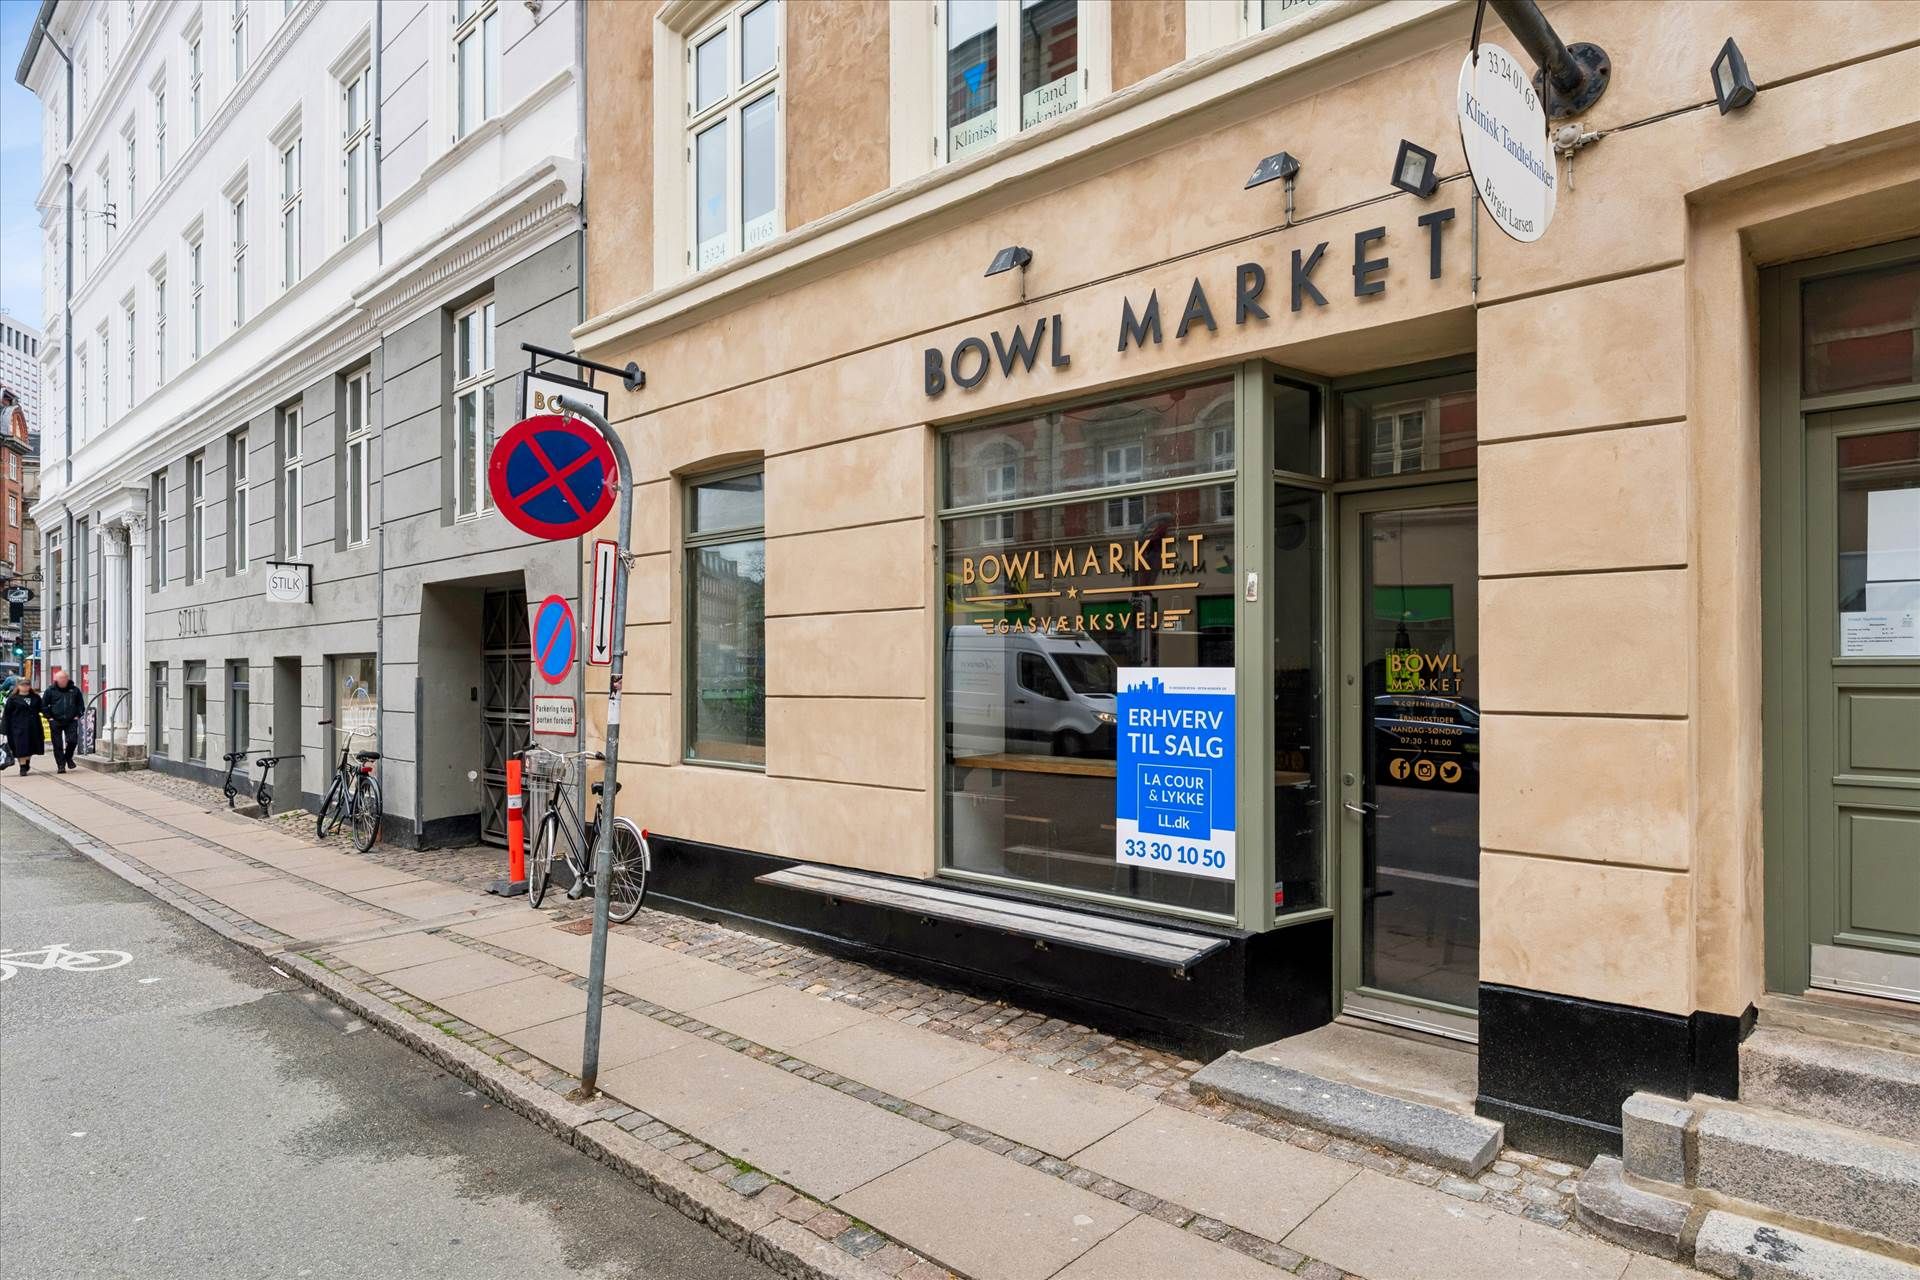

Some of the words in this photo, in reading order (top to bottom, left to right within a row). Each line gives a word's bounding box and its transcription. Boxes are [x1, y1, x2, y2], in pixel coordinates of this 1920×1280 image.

[1035, 78, 1068, 106] Tand
[1488, 51, 1499, 75] 33
[1501, 58, 1511, 83] 24
[1513, 69, 1523, 94] 01
[1525, 88, 1535, 112] 63
[954, 119, 998, 150] Klinisk
[1465, 92, 1499, 142] Klinisk
[1502, 125, 1554, 190] Tandtekniker
[1485, 178, 1507, 217] Birgit
[1509, 208, 1534, 233] Larsen
[750, 221, 773, 242] 0163
[924, 313, 1071, 397] BOWL
[1118, 207, 1456, 352] MARKET
[271, 576, 300, 590] STILK
[997, 612, 1158, 635] GASVÆRKSVEJ
[1391, 654, 1462, 673] BOWL
[1391, 678, 1462, 691] MARKET
[536, 705, 559, 714] Parkering
[1129, 708, 1223, 730] ERHVERV
[554, 717, 573, 725] forbudt
[1127, 733, 1160, 754] TIL
[1164, 734, 1224, 759] SALG
[1400, 737, 1422, 745] 07:30
[1144, 773, 1161, 786] LA
[1164, 775, 1204, 789] COUR
[1149, 789, 1159, 802] &
[1162, 790, 1204, 806] LYKKE
[1158, 814, 1190, 830] LL.dk
[1125, 839, 1146, 858] 33
[1150, 842, 1172, 861] 30
[1177, 846, 1199, 865] 10
[1202, 849, 1226, 868] 50
